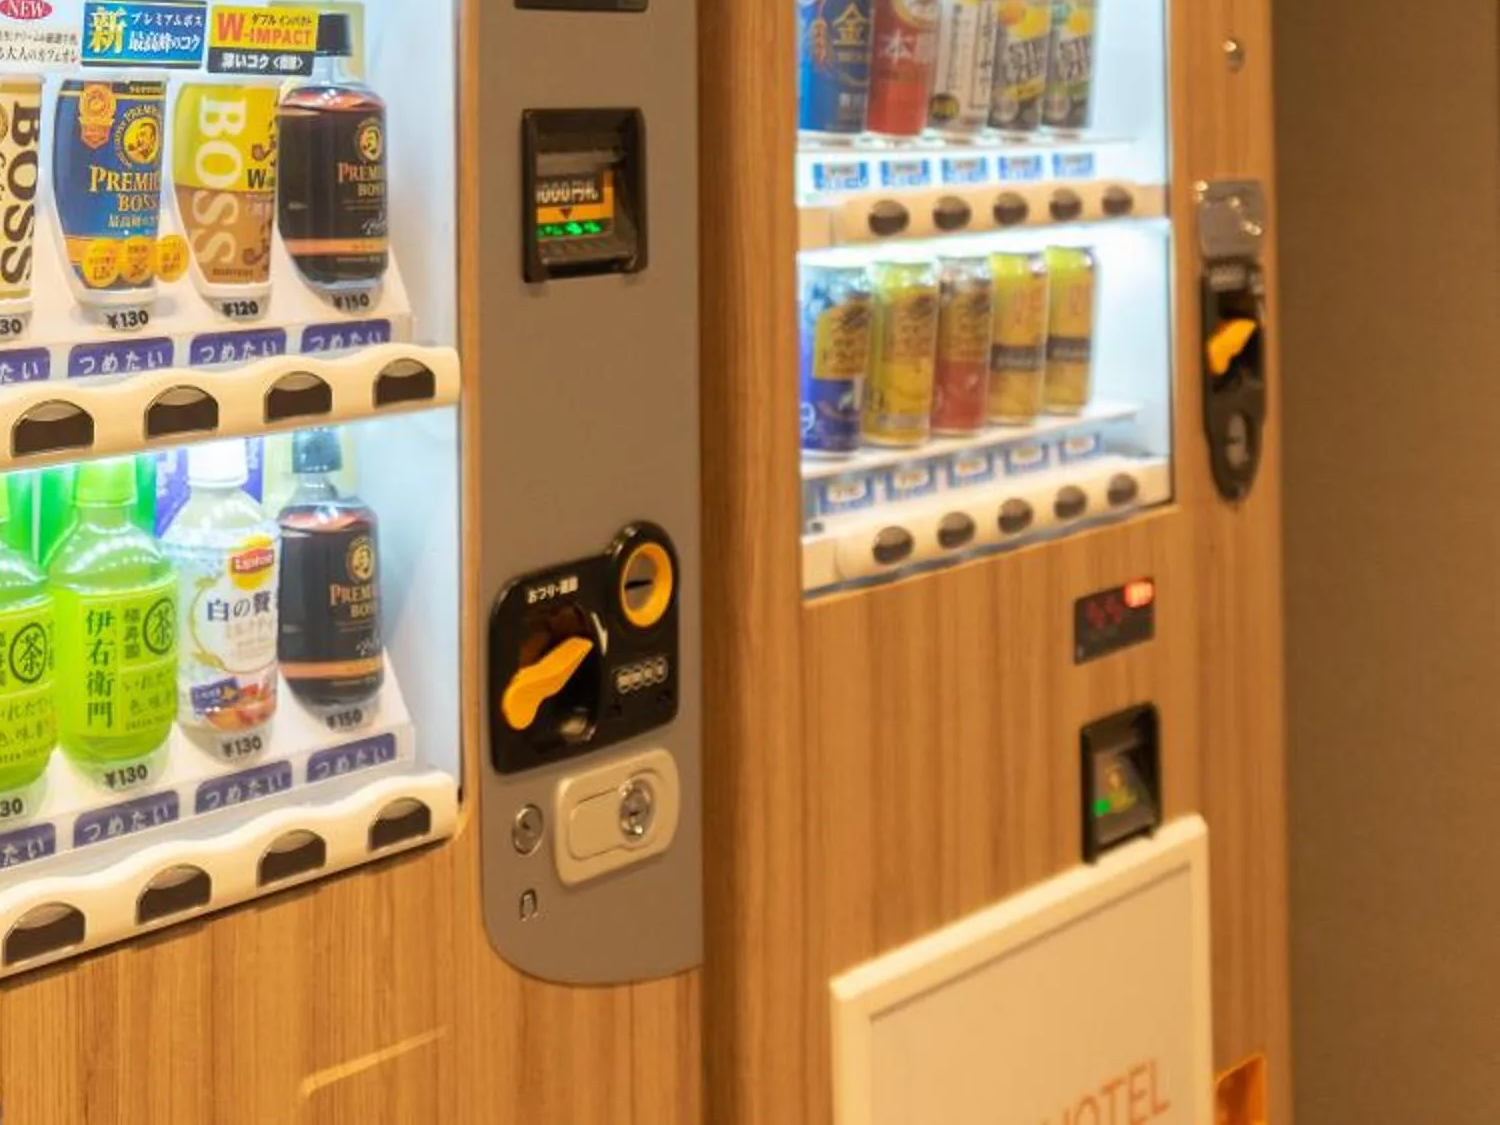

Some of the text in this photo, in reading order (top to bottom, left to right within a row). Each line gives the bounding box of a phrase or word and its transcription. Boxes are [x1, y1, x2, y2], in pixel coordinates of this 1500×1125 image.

[88, 5, 129, 54] 新
[130, 12, 203, 27] プレミアムボス
[215, 12, 313, 48] W-IMPACT
[0, 101, 42, 284] BOSS
[191, 93, 248, 265] BOSS
[105, 309, 150, 330] ¥130
[199, 339, 278, 362] つめたい
[309, 329, 383, 352] つめたい
[78, 349, 164, 374] つめたい
[18, 632, 44, 676] 茶
[85, 609, 117, 730] 伊右衛門
[220, 735, 263, 758] ¥130
[103, 763, 149, 788] ¥130
[204, 772, 284, 810] つめたい
[82, 805, 170, 838] つめたい
[1062, 1058, 1172, 1125] OTEL
